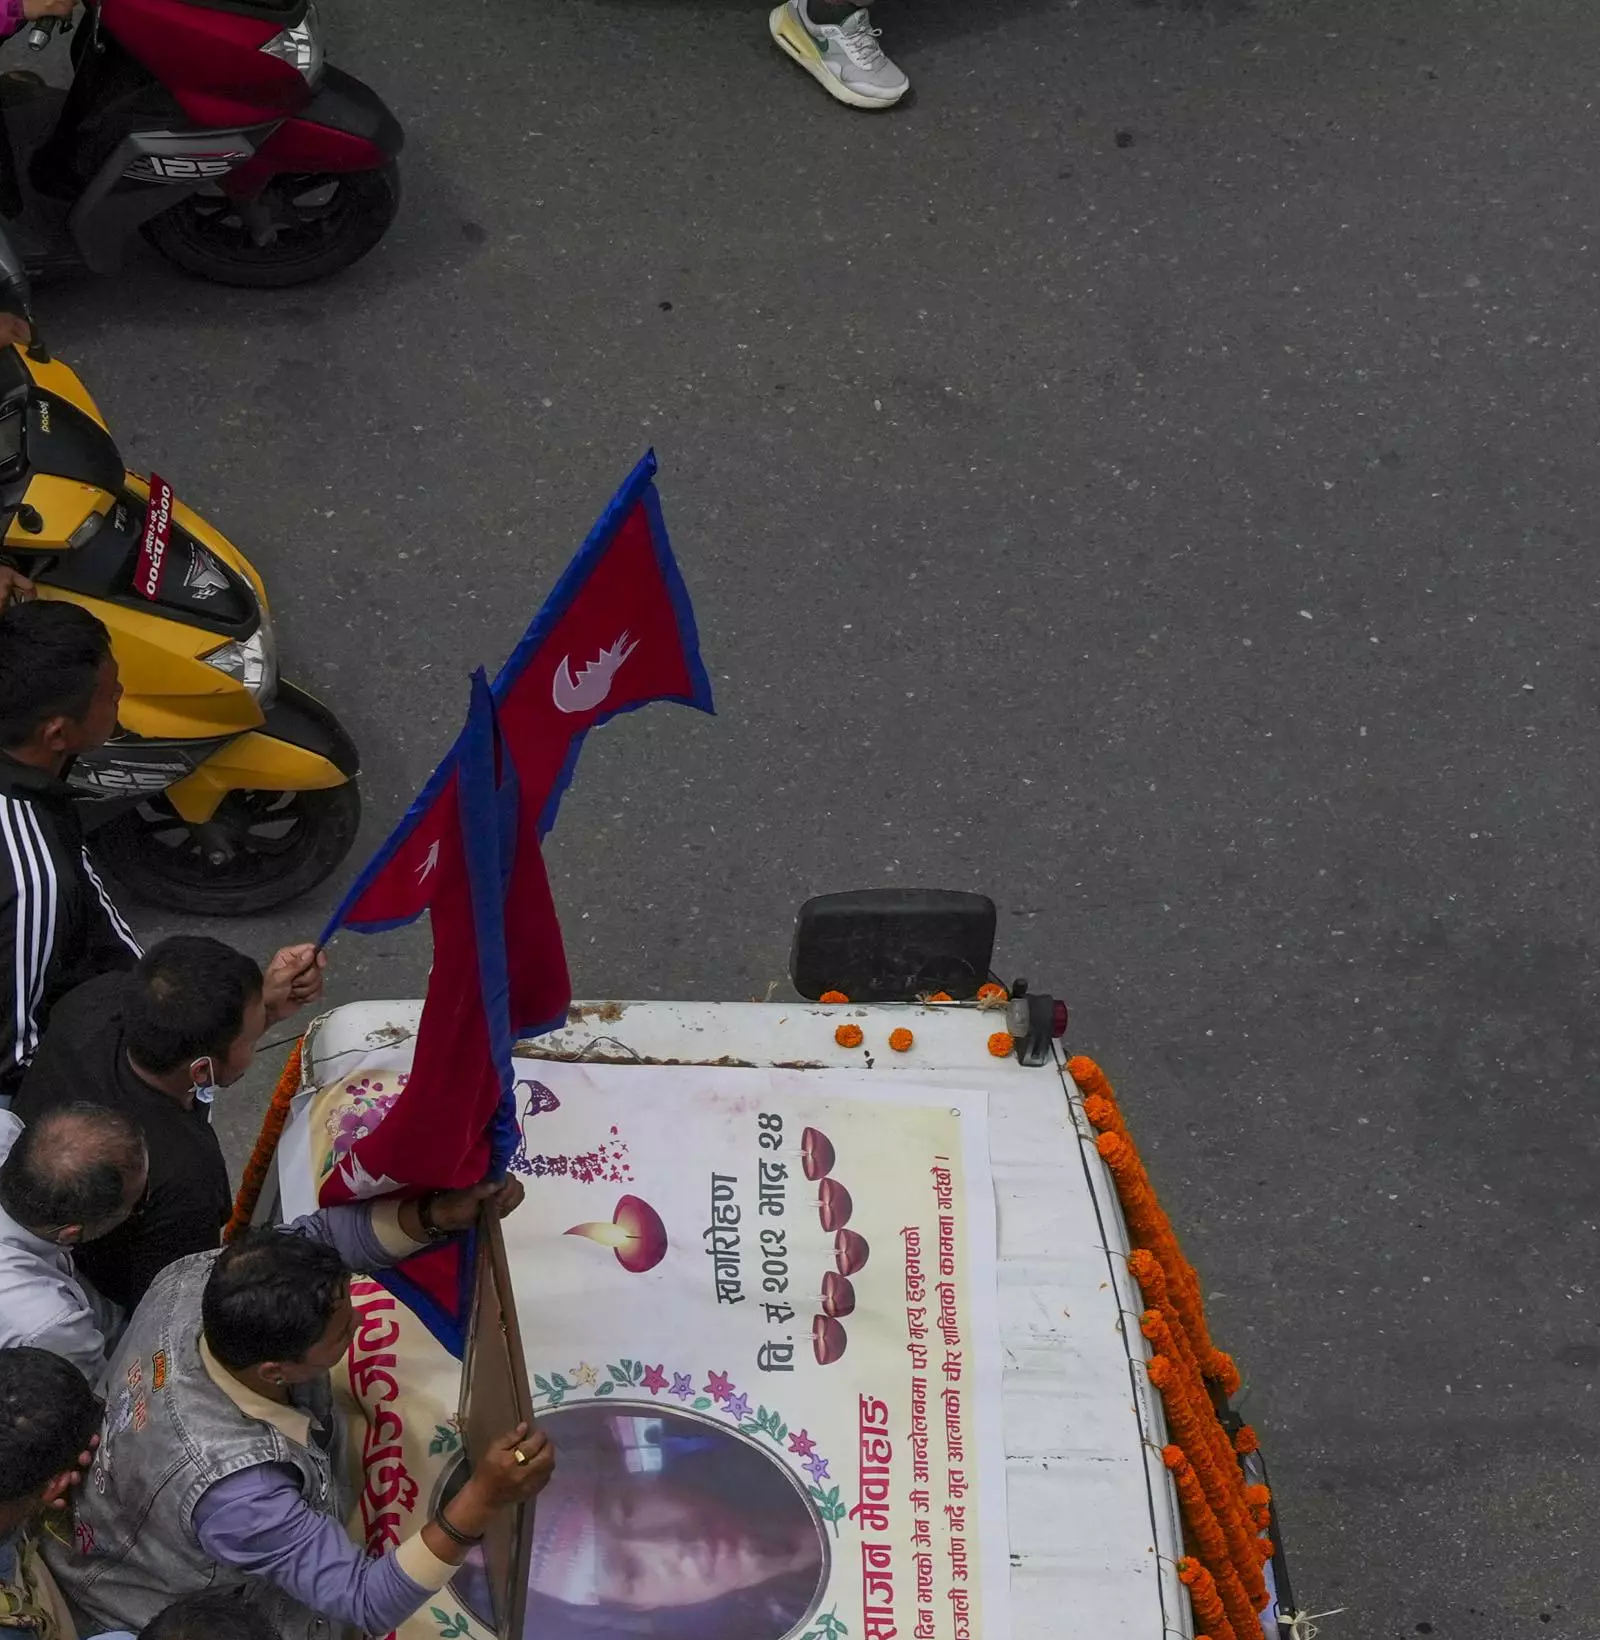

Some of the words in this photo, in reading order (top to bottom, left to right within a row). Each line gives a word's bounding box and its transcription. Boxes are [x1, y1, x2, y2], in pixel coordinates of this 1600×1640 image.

[151, 155, 234, 178] 125
[87, 767, 168, 790] 125
[759, 1112, 782, 1150] २४
[759, 1159, 788, 1216] भाद्र
[703, 1172, 746, 1304] स्वर्गारोहण
[938, 1216, 956, 1275] कामना
[760, 1229, 788, 1293] २०८२
[900, 1226, 925, 1302] हुनुभएको
[906, 1307, 928, 1339] मृत्यु
[934, 1283, 958, 1345] शान्तिको
[757, 1336, 794, 1372] वि.
[908, 1344, 927, 1370] परी
[935, 1350, 961, 1381] चीर
[908, 1378, 929, 1483] आन्दोलनमा
[941, 1389, 963, 1462] आत्माको
[849, 1393, 892, 1531] मेवाहाङ
[911, 1490, 930, 1513] जी
[944, 1470, 968, 1498] मृत
[911, 1520, 931, 1547] जेन
[943, 1505, 966, 1531] गर्दै
[912, 1552, 933, 1602] भएको
[944, 1537, 968, 1581] अर्पण
[914, 1610, 936, 1640] दिन
